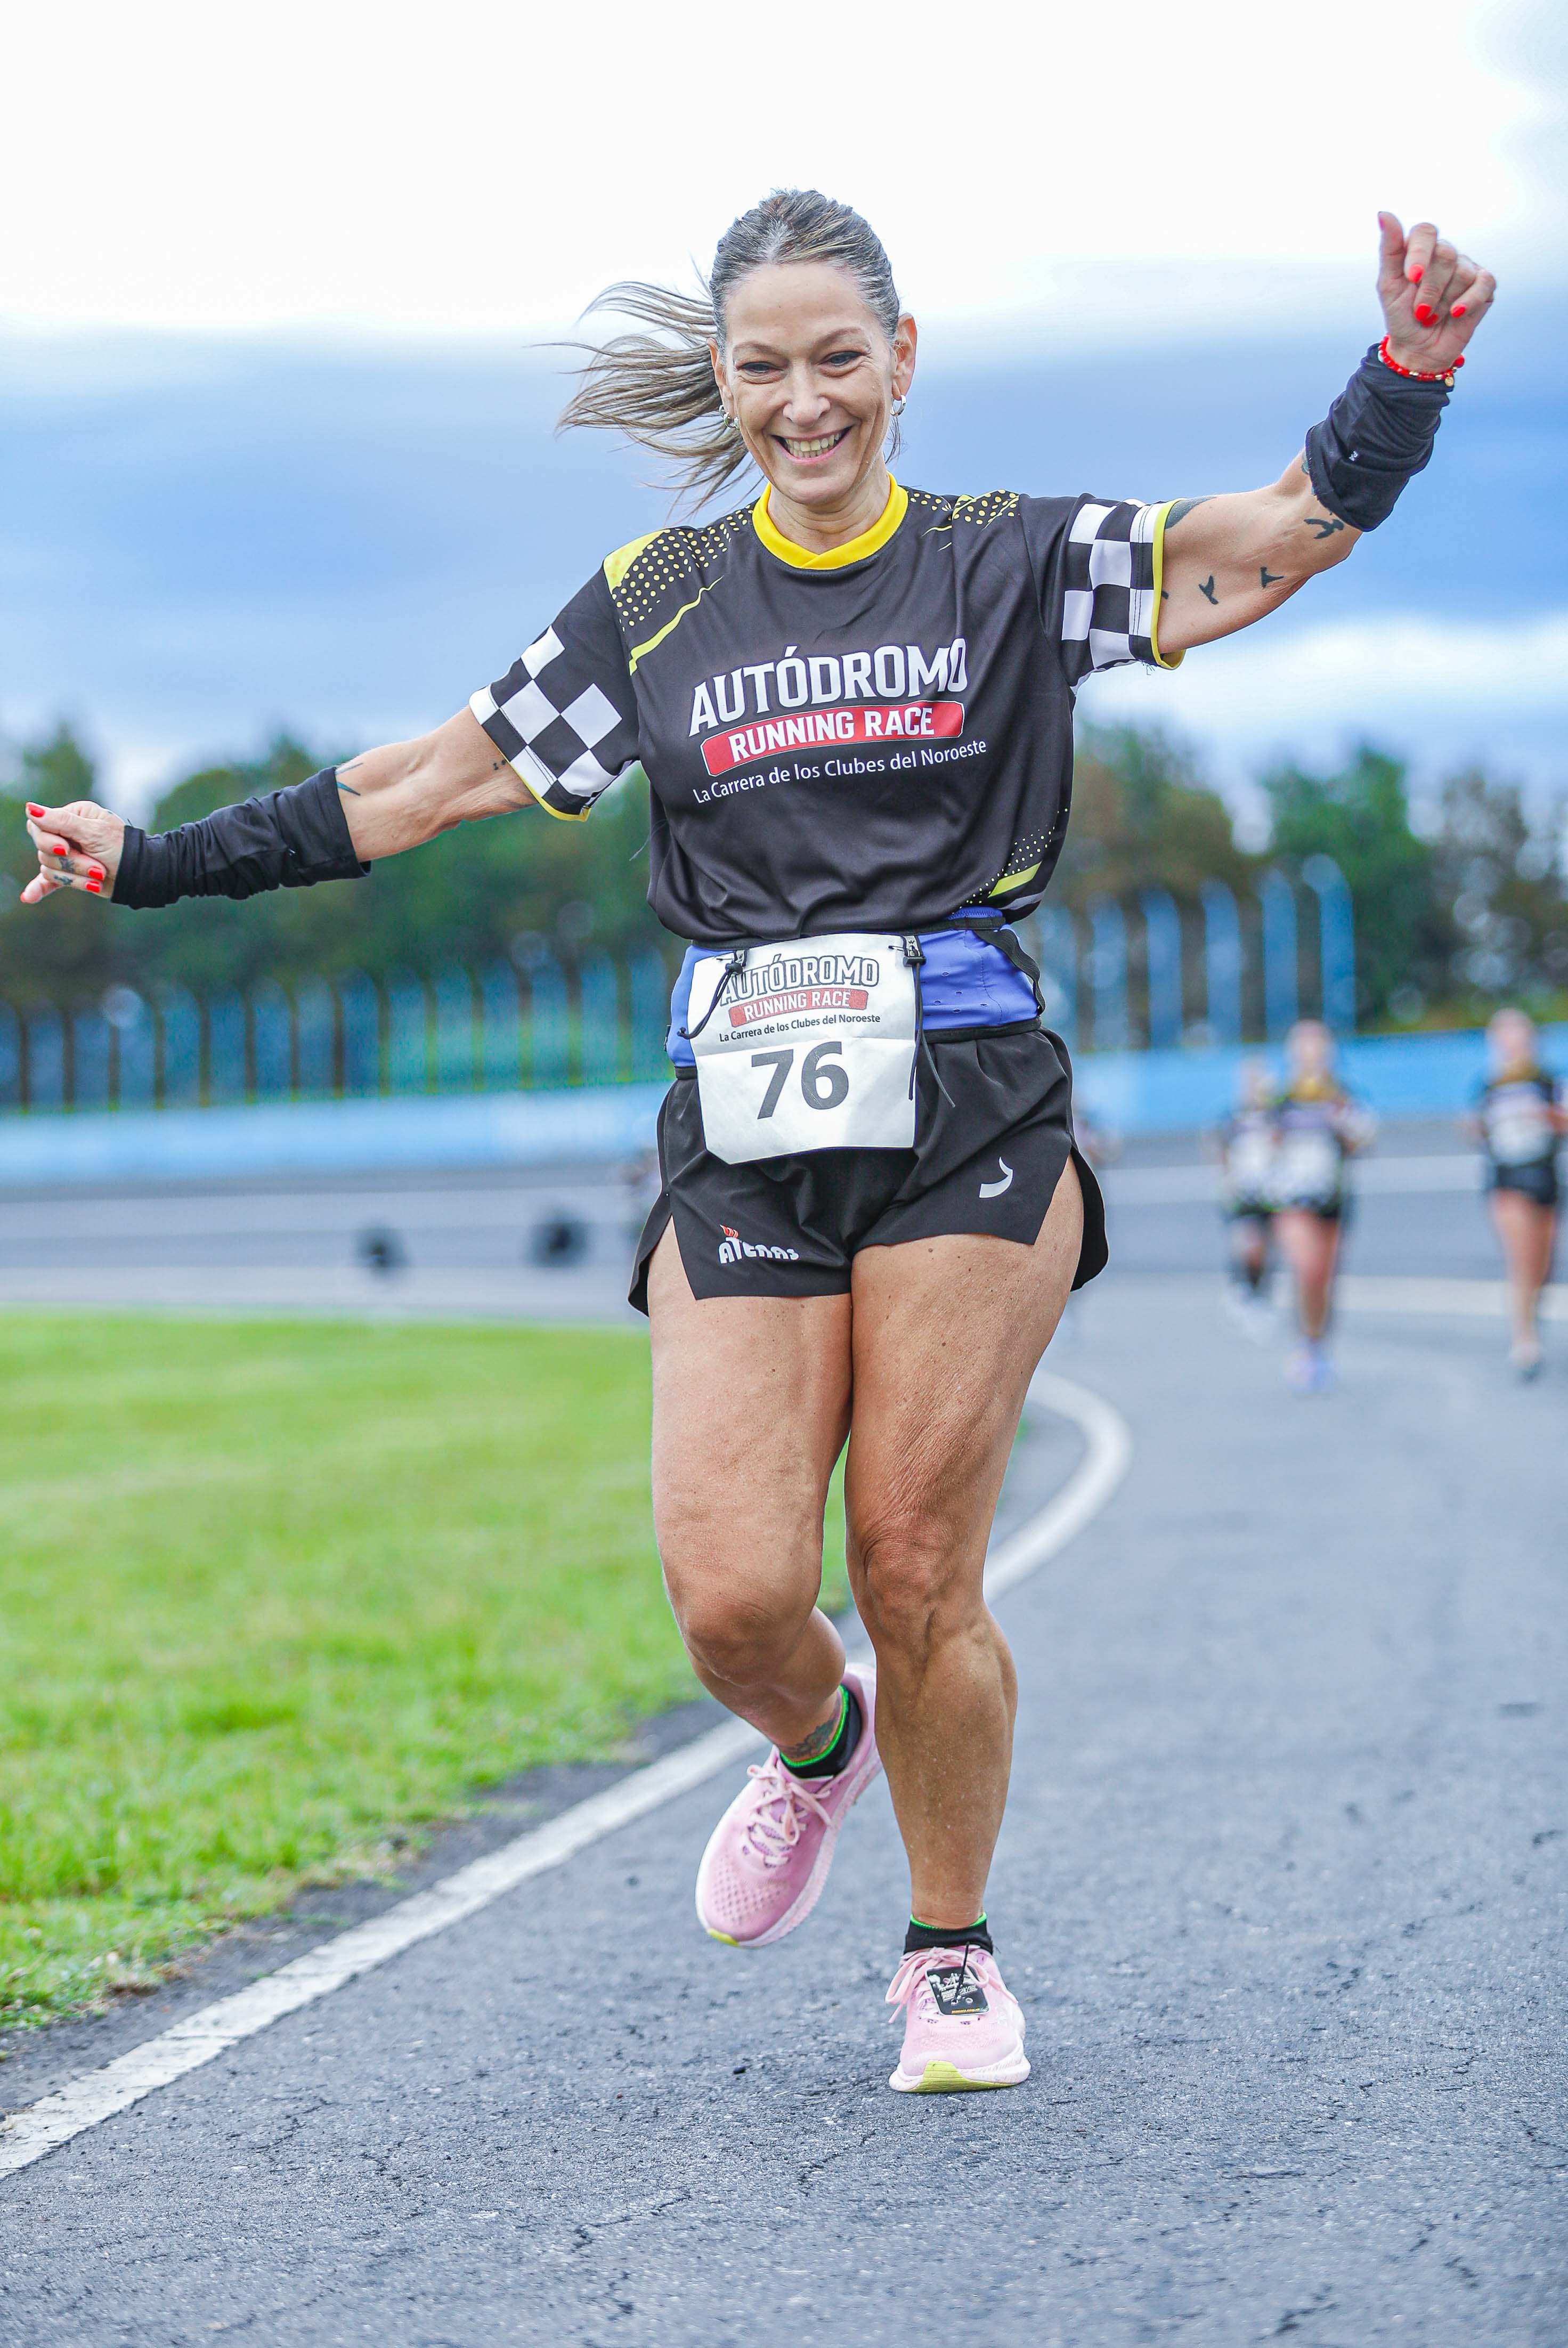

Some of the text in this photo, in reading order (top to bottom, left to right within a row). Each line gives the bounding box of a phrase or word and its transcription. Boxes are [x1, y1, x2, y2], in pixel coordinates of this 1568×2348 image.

[688, 638, 968, 737] AUTÓDROMO
[727, 706, 935, 763] RUNNING RACE
[693, 740, 987, 803] La Carrera de los Clubes del Noroeste
[720, 953, 879, 1006] AUTÓDROMO
[743, 990, 851, 1022] RUNNING RACE
[719, 1033, 729, 1042] La
[731, 1028, 762, 1041] Carrera
[764, 1024, 775, 1034] de
[777, 1022, 789, 1032] los
[791, 1018, 820, 1029] Clubes
[823, 1014, 836, 1024] del
[751, 1041, 849, 1119] 76
